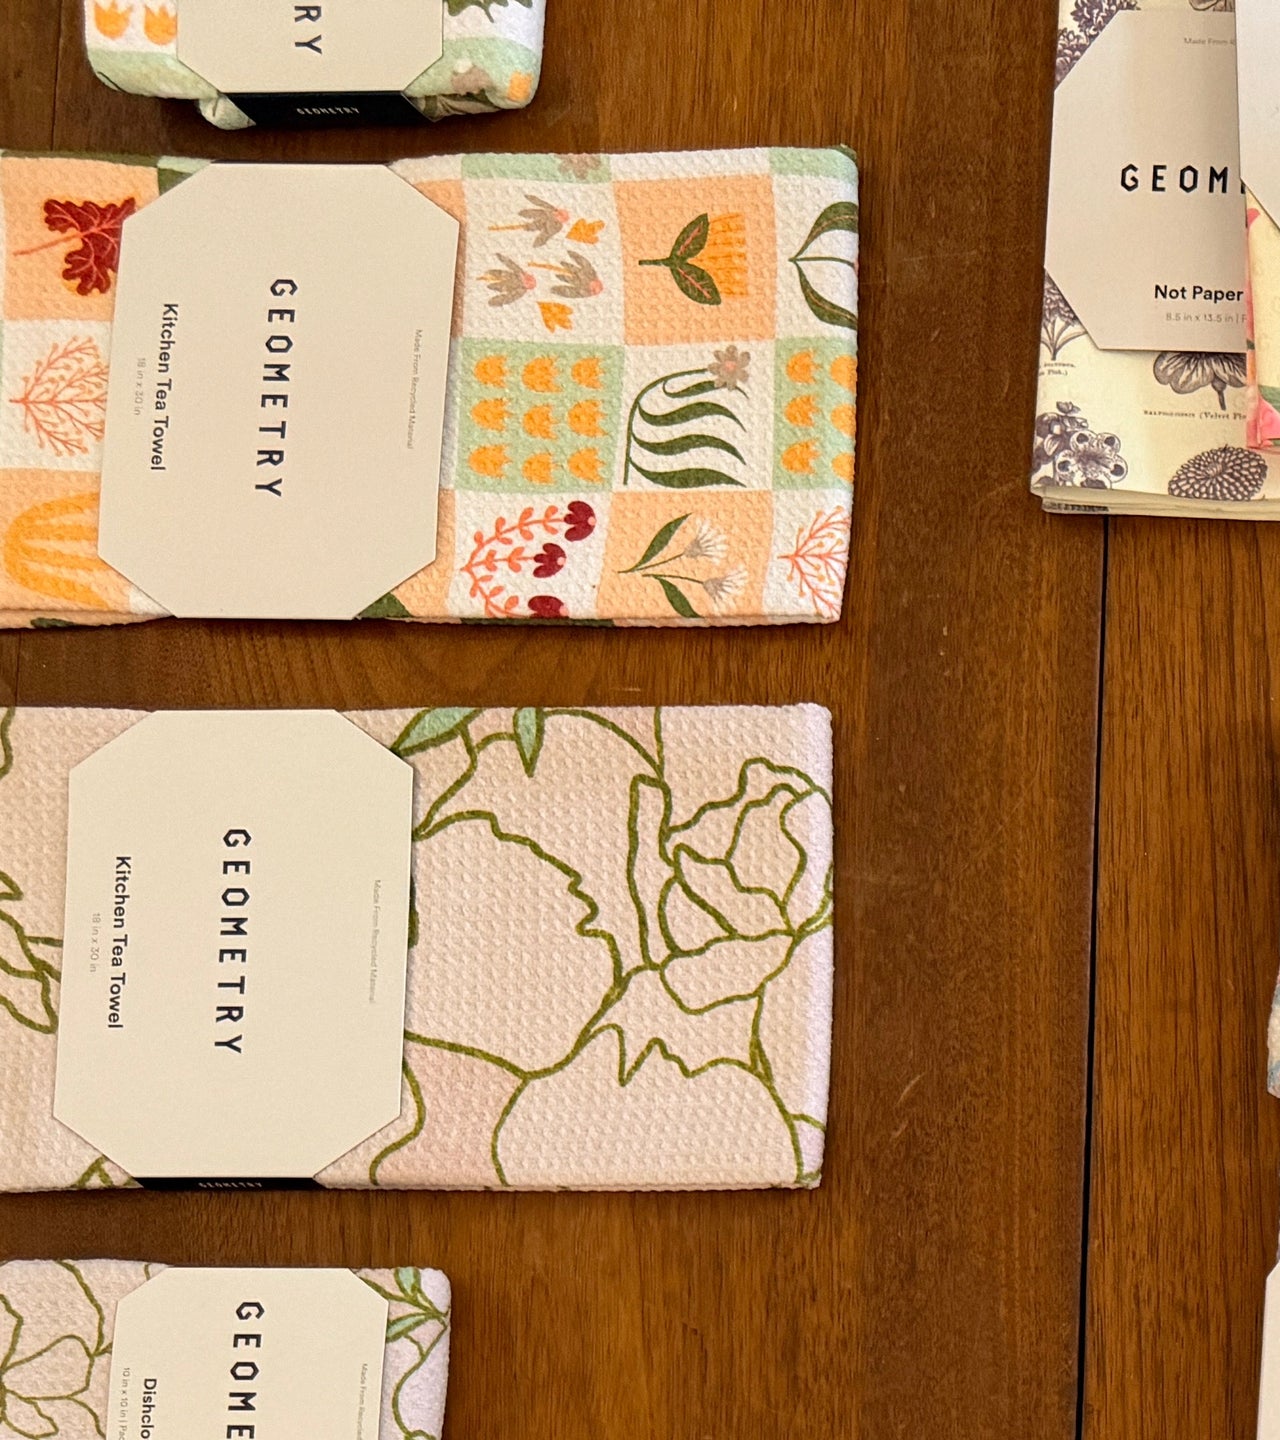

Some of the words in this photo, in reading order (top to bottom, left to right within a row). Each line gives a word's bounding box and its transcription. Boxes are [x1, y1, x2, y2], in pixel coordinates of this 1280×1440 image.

[1154, 284, 1187, 299] Not
[1192, 285, 1244, 304] Paper
[157, 303, 179, 373] Kitchen
[155, 378, 172, 410] Tea
[254, 278, 298, 497] GEOMETRY
[150, 415, 169, 470] Towel
[113, 856, 131, 928] Kitchen
[111, 933, 128, 967] Tea
[214, 828, 252, 1053] GEOMETRY
[107, 972, 126, 1028] Towel
